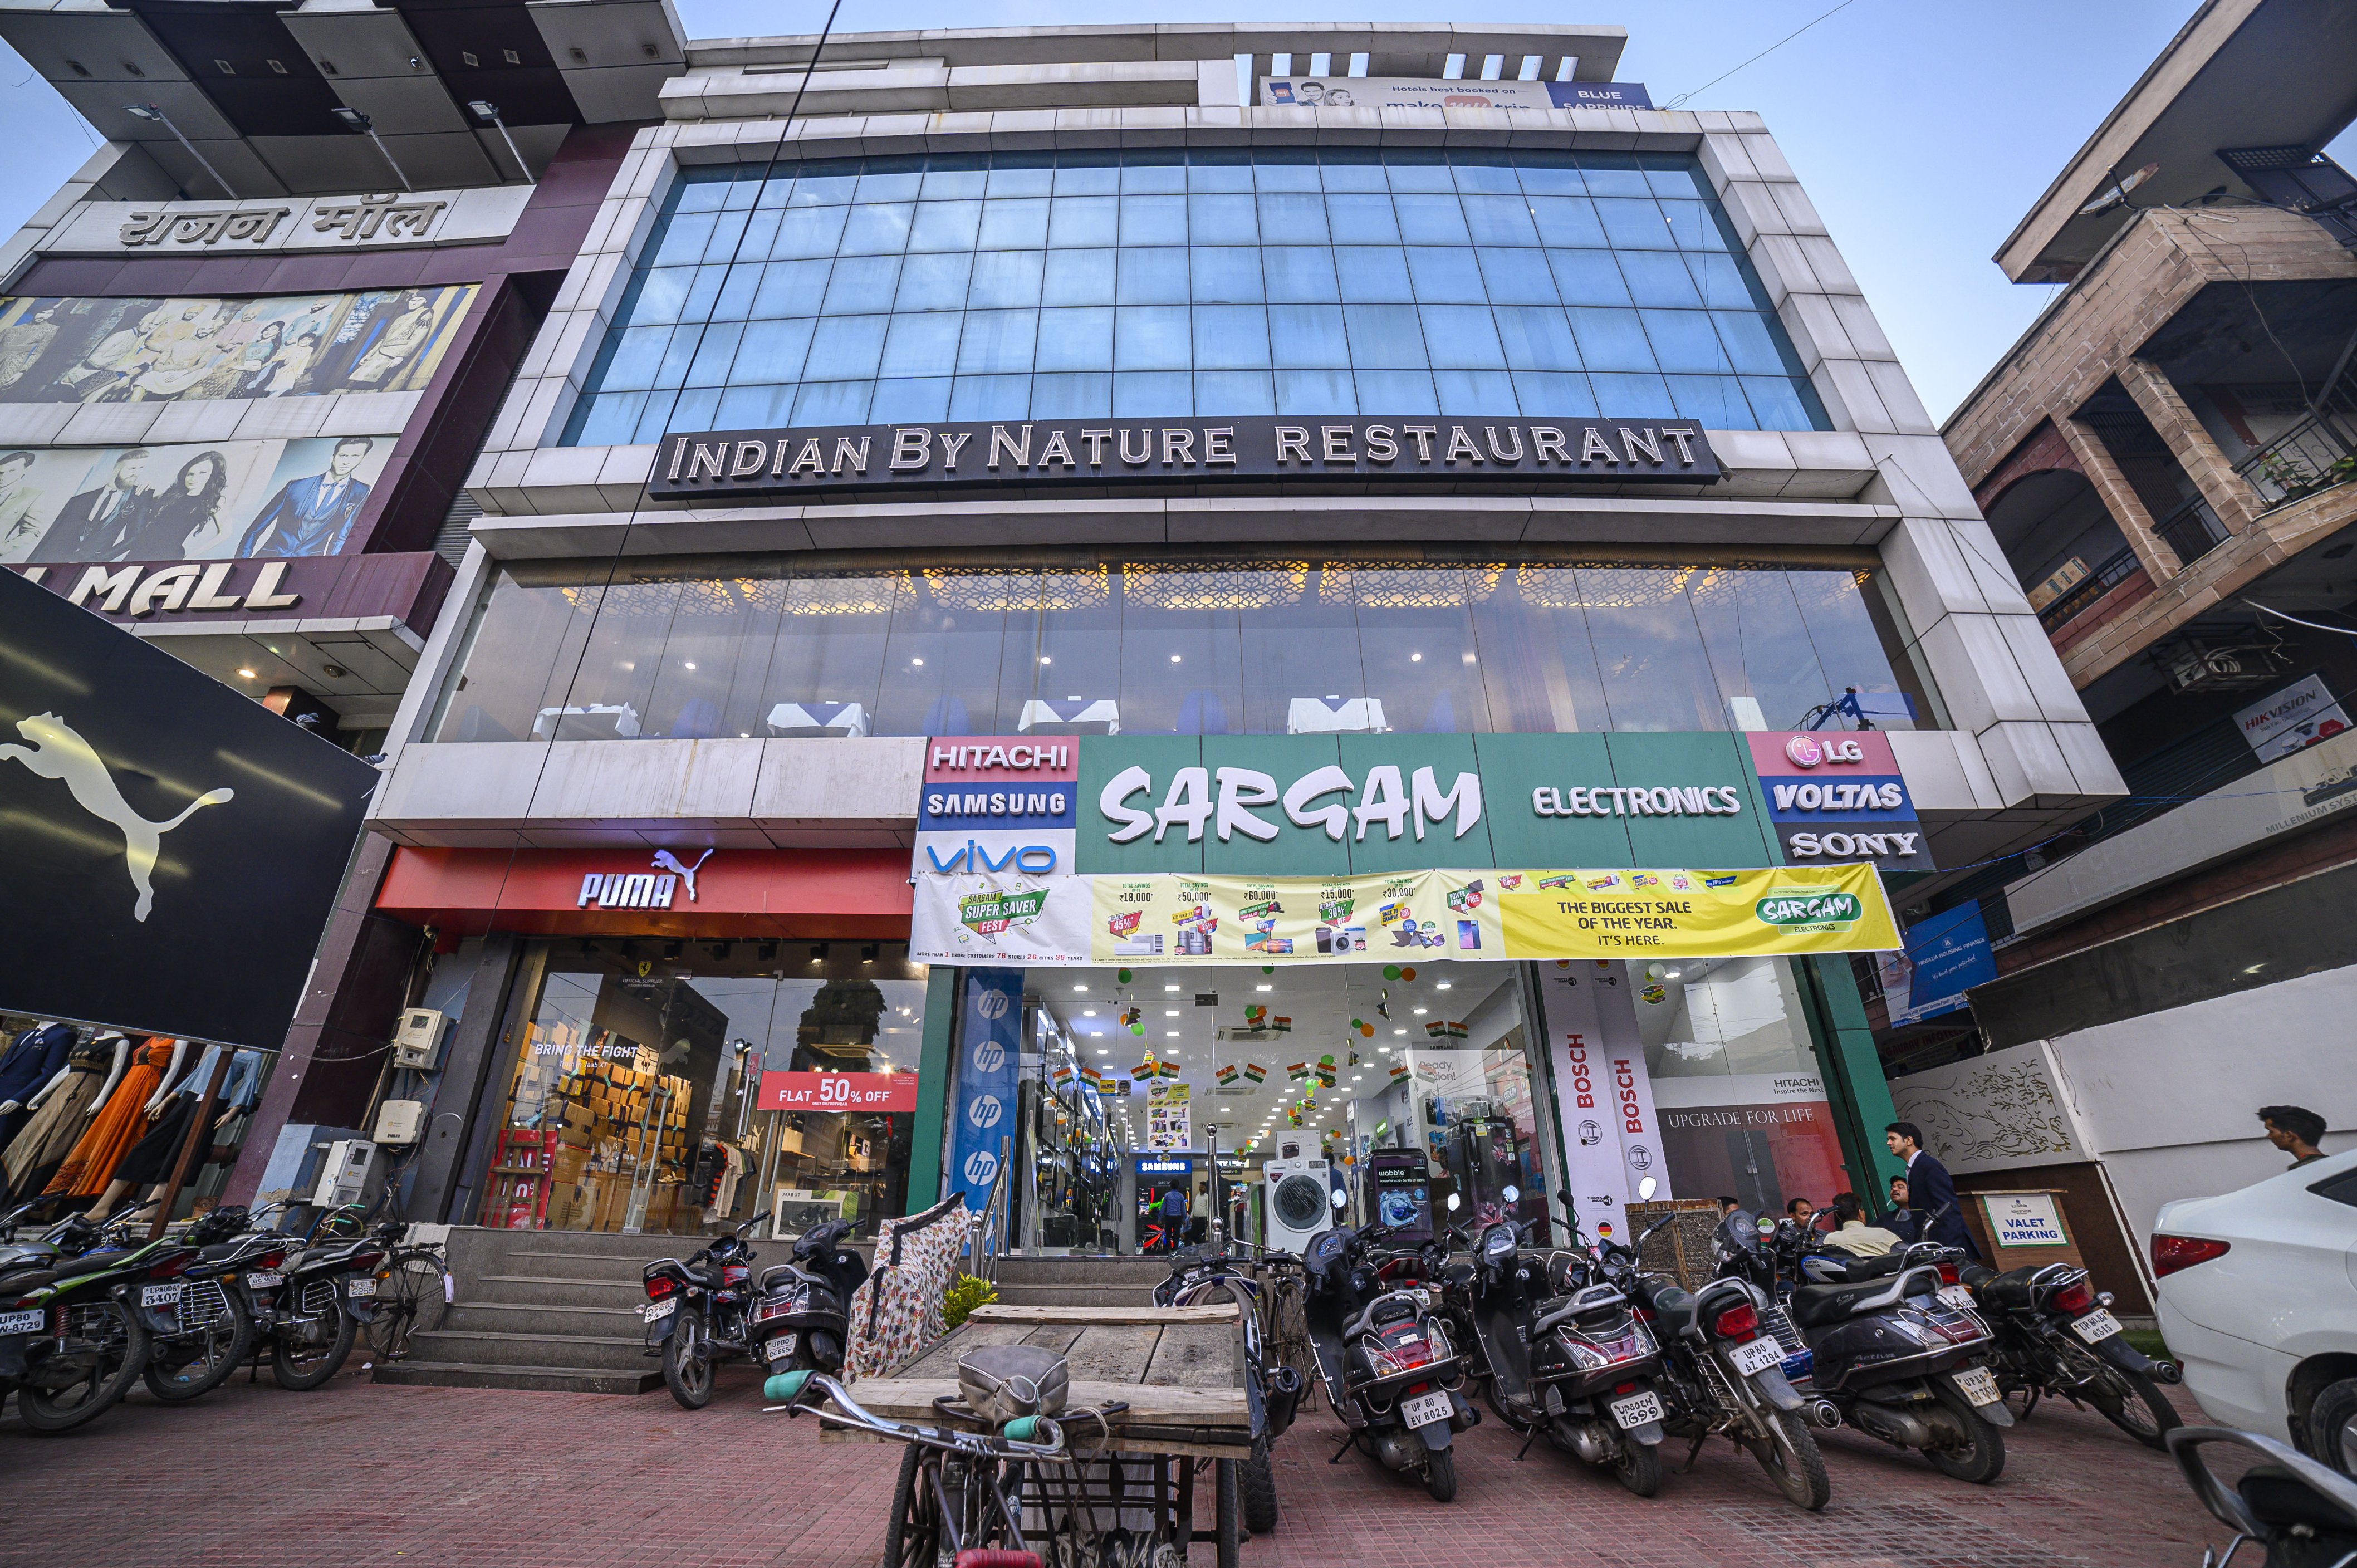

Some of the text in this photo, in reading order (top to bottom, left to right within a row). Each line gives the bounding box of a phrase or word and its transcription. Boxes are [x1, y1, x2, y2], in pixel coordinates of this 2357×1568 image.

[1577, 91, 1622, 100] BLUE
[119, 193, 448, 246] राजन मॉल
[1275, 423, 1697, 467] RESTAURANT
[68, 561, 303, 619] MALL
[2245, 689, 2317, 731] HIKVISION
[932, 745, 1068, 771] HITACHI
[1822, 739, 1863, 763] LG
[927, 793, 1066, 817] SAMSUNG
[1099, 764, 1741, 843] SARGAM ELECTRONICS
[1773, 783, 1903, 811] VOLTAS
[2265, 805, 2328, 834] MILLENIUM
[1789, 831, 1918, 858] SONY
[926, 839, 1057, 874] vivo
[577, 873, 678, 910] PUMA
[968, 893, 997, 903] SARGAM
[1449, 890, 1466, 900] POWER
[1467, 894, 1480, 904] FREE
[965, 899, 1036, 920] SUPER SAVER
[1557, 901, 1692, 914] THE BIGGEST SALE
[1762, 896, 1853, 921] SARGAM
[981, 920, 1003, 933] FEST
[1337, 916, 1346, 924] OFF
[1577, 917, 1678, 930] OF THE YEAR.
[1794, 924, 1836, 933] ELECTRONICS
[1598, 935, 1665, 946] IT'S HERE.
[1918, 937, 1986, 966] HINDUJA HOUSING FINANCE
[534, 1043, 639, 1058] BRING THE FIGHT
[975, 1041, 1003, 1073] hp
[1567, 1034, 1594, 1108] BOSCH
[1773, 1078, 1820, 1087] HITACHI
[779, 1090, 812, 1102] FLAT
[1614, 1060, 1643, 1133] BOSCH
[971, 1095, 1000, 1129] hp
[1668, 1108, 1815, 1128] UPGRADE FOR LIFE
[966, 1150, 996, 1186] hp
[1141, 1162, 1185, 1171] SAMSUNG
[2005, 1218, 2045, 1228] VALET
[2002, 1229, 2058, 1241] PARKING
[146, 1292, 178, 1306] 3407
[150, 1285, 177, 1294] UP80DA
[352, 1287, 374, 1296] 2265
[0, 1313, 31, 1324] UP80
[1743, 1343, 1767, 1359] UP80
[1853, 1353, 1896, 1361] Activa
[1745, 1351, 1781, 1373] AZ 1294
[1410, 1398, 1435, 1412] UP 80
[1410, 1406, 1449, 1427] EV 8025
[1622, 1409, 1659, 1427] 1699
